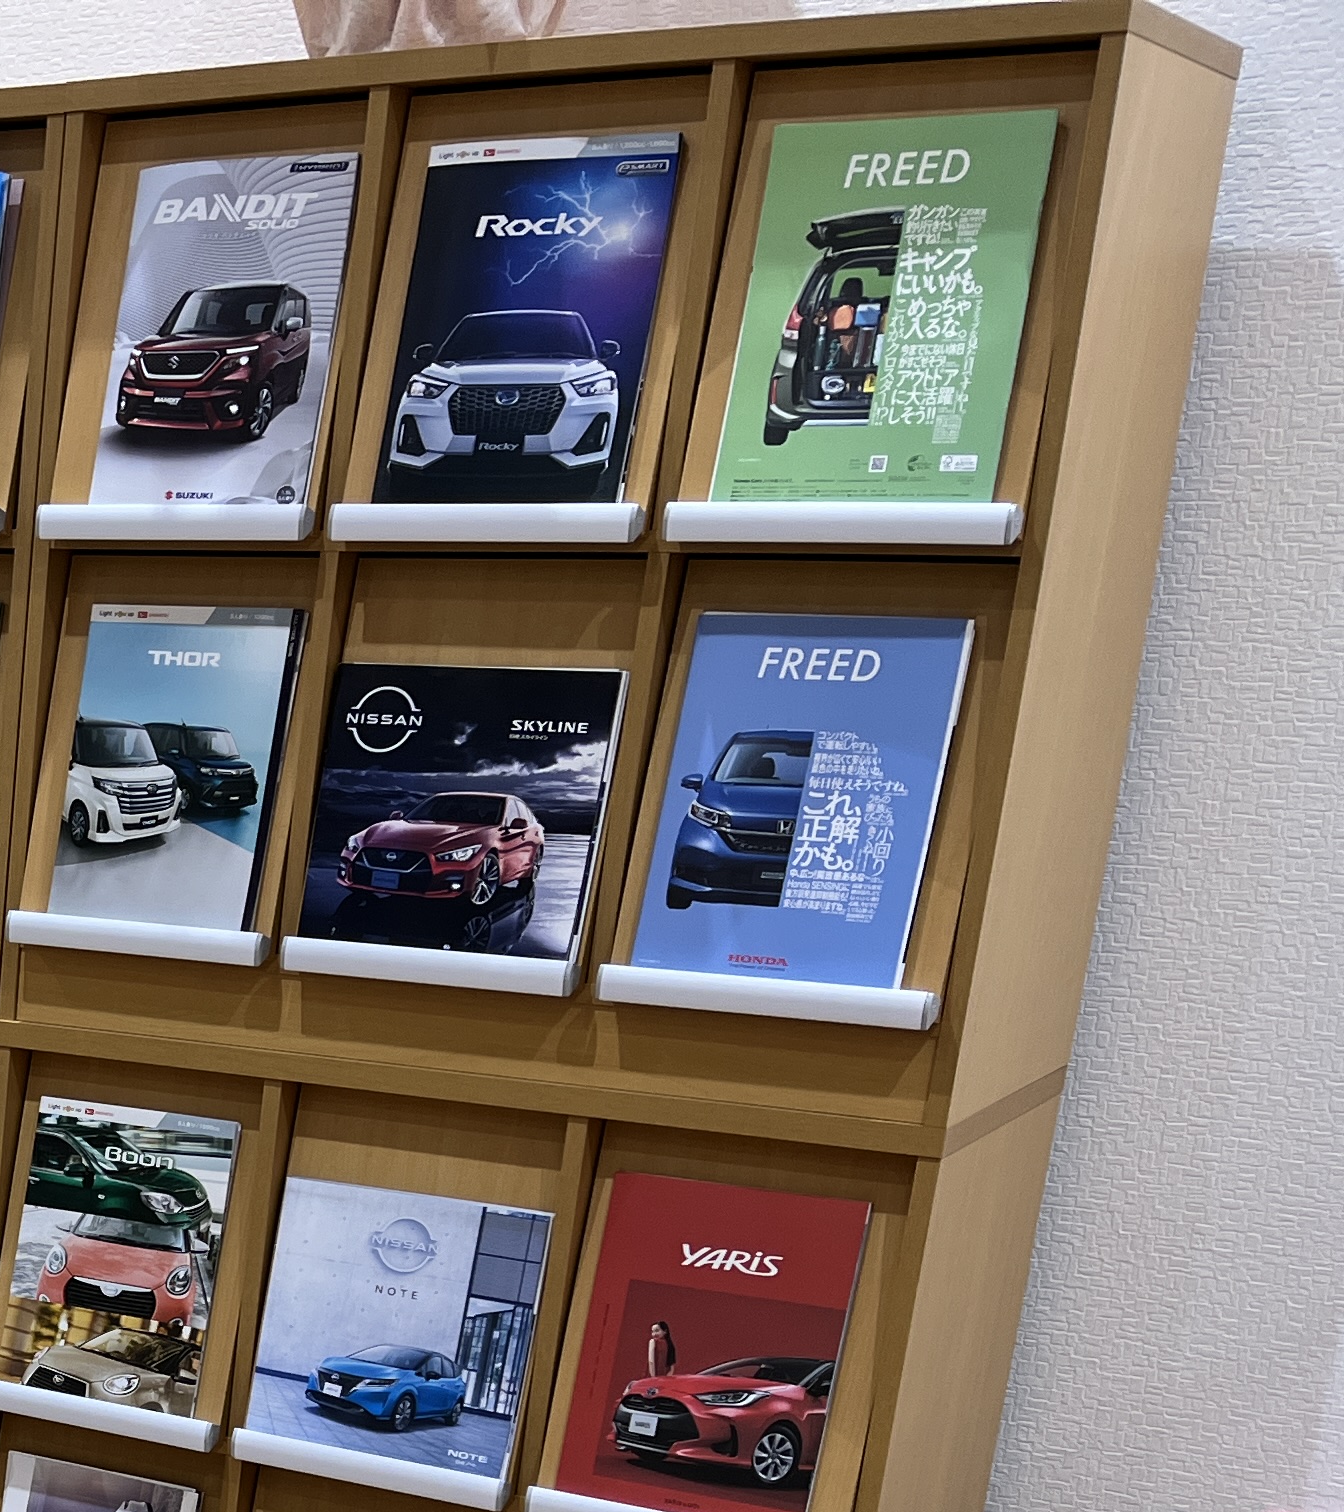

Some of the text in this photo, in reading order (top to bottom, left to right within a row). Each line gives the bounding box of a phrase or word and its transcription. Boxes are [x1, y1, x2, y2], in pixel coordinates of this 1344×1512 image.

[843, 148, 971, 189] FREED
[153, 192, 319, 226] BANDIT
[907, 204, 960, 220] ガンガン
[245, 218, 300, 231] SOLIO
[475, 213, 604, 238] Rocky
[899, 245, 978, 272] キャンプ
[896, 268, 983, 295] にいいかも。
[907, 296, 972, 318] めっちゃ
[903, 316, 967, 340] 入るな。
[896, 368, 959, 387] アウトドア
[478, 442, 520, 453] Rocky
[148, 650, 221, 667] THOR
[757, 647, 882, 682] FREED
[346, 711, 423, 727] NISSAN
[510, 719, 590, 734] SKYLINE
[816, 731, 860, 740] コンパクト
[802, 790, 862, 816] これ、
[796, 815, 862, 845] 正解
[791, 841, 854, 871] かも。
[728, 953, 789, 967] HONDA
[371, 1234, 439, 1254] NISSAN
[375, 1285, 418, 1300] NOTE
[447, 1449, 489, 1464] NOTE
